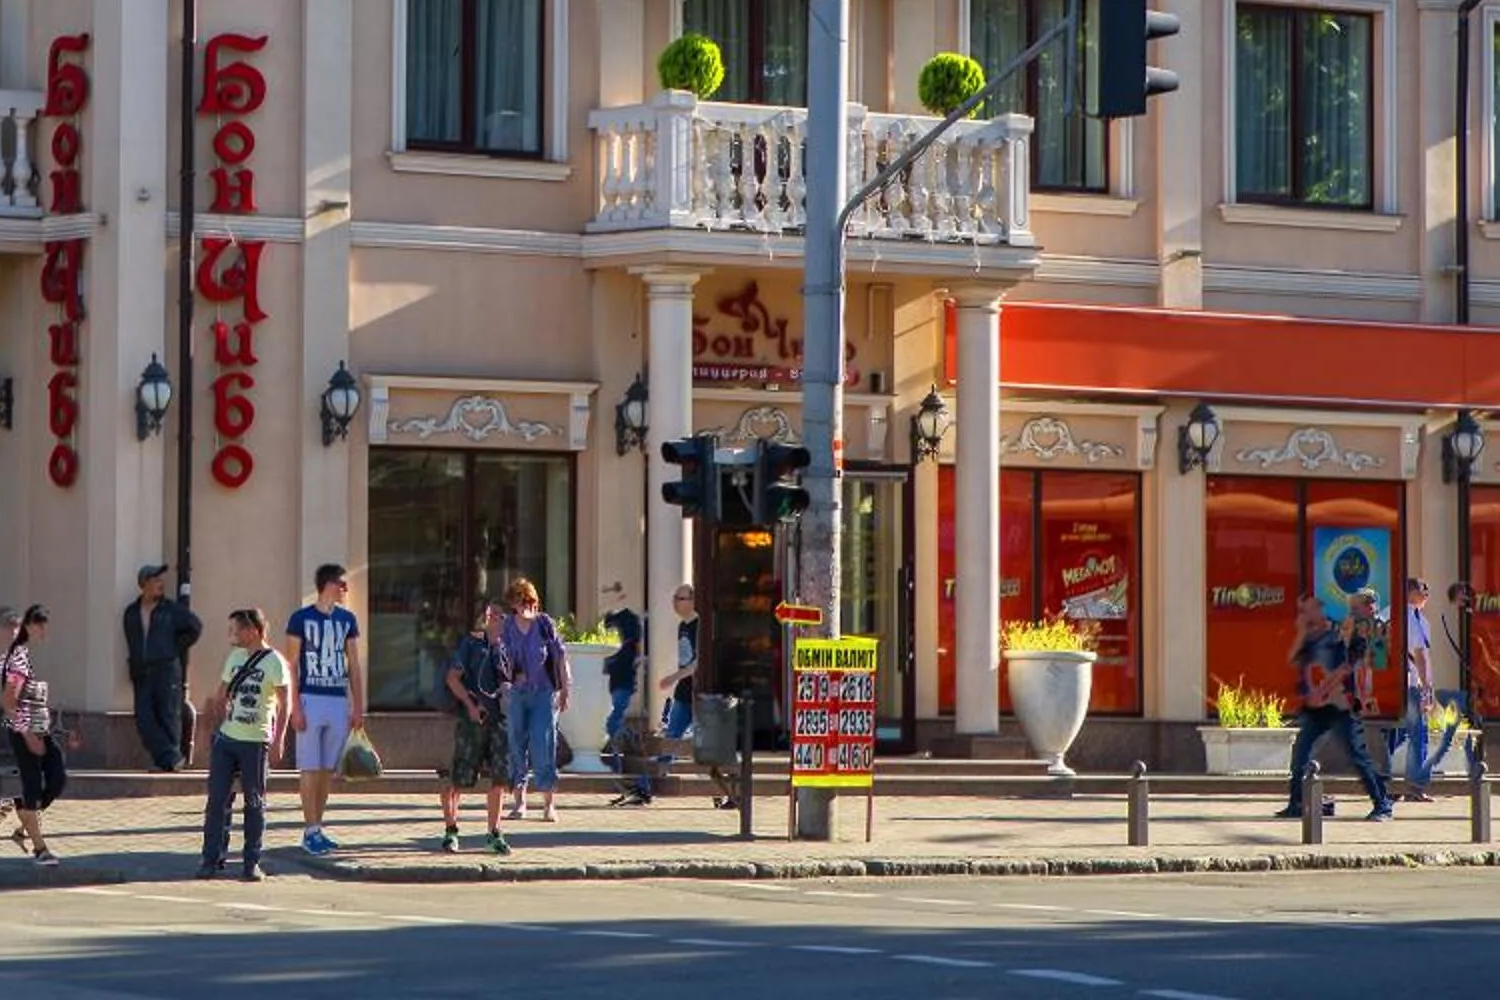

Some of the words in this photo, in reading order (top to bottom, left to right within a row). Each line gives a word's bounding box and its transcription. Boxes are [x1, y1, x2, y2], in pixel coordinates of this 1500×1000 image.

[41, 33, 90, 213] Бон
[196, 34, 269, 213] Бон
[197, 239, 268, 488] Цибо
[797, 648, 833, 668] ОБМІН
[835, 648, 875, 669] ВАЛЮТ
